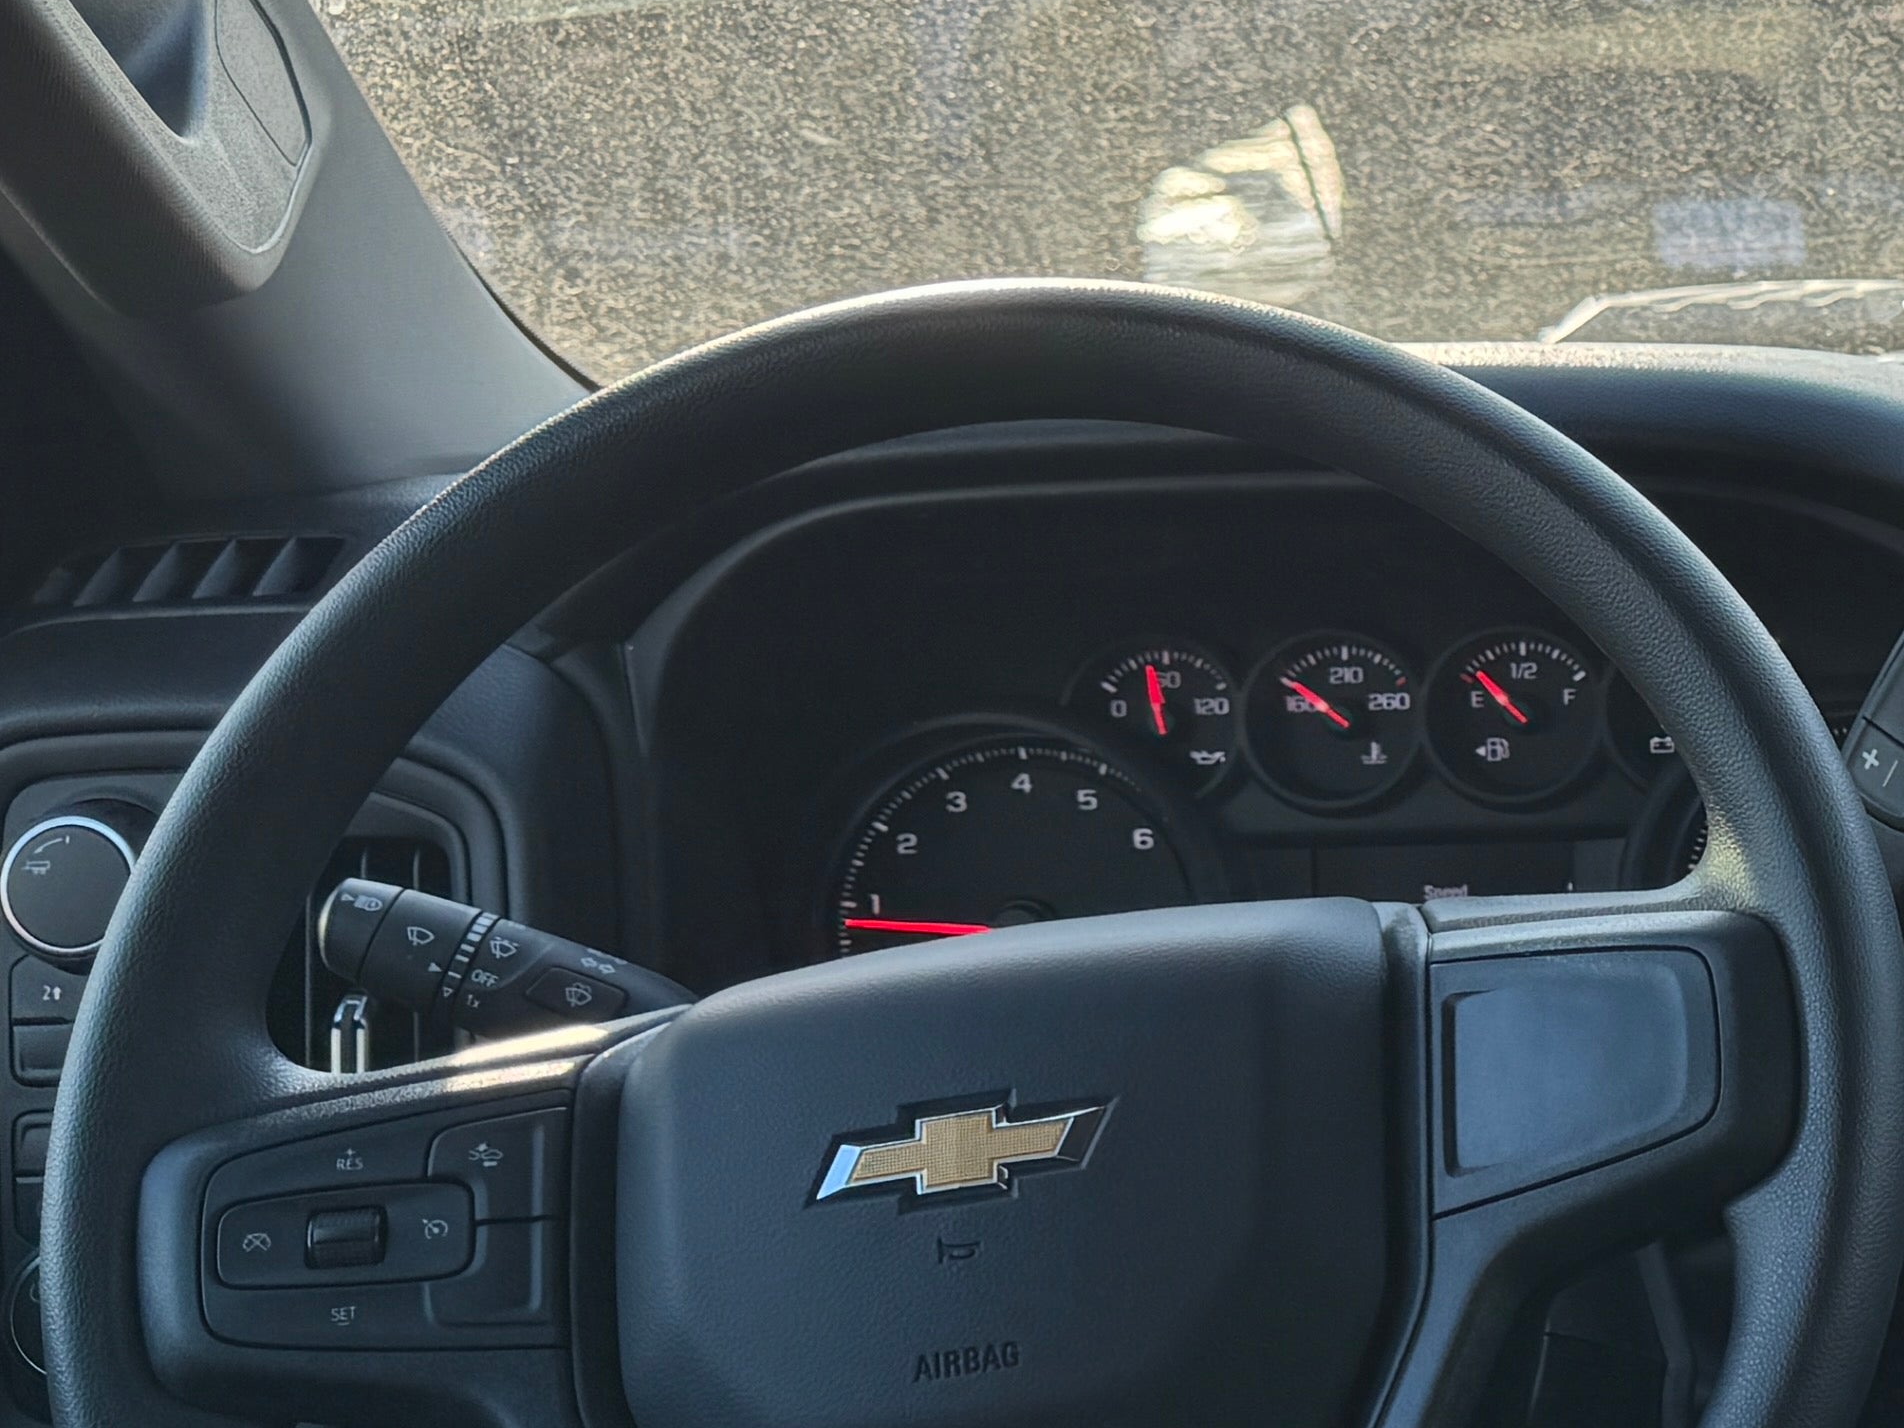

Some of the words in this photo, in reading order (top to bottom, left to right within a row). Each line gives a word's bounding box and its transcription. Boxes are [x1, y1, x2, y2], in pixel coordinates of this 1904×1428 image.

[1328, 666, 1364, 685] 210
[1509, 662, 1538, 680] 1/2
[1193, 697, 1230, 716] 120
[1367, 692, 1412, 711] 260
[1470, 691, 1484, 709] E
[1562, 689, 1577, 706] F
[1110, 699, 1128, 719] 0
[1011, 772, 1033, 793] 4
[945, 791, 968, 813] 3
[1075, 789, 1099, 811] 5
[896, 833, 919, 855] 2
[1131, 827, 1155, 851] 6
[870, 893, 881, 915] 1
[471, 969, 499, 988] OFF
[336, 1156, 363, 1171] RES
[331, 1306, 357, 1322] SET
[911, 1341, 1020, 1383] AIRBAG
